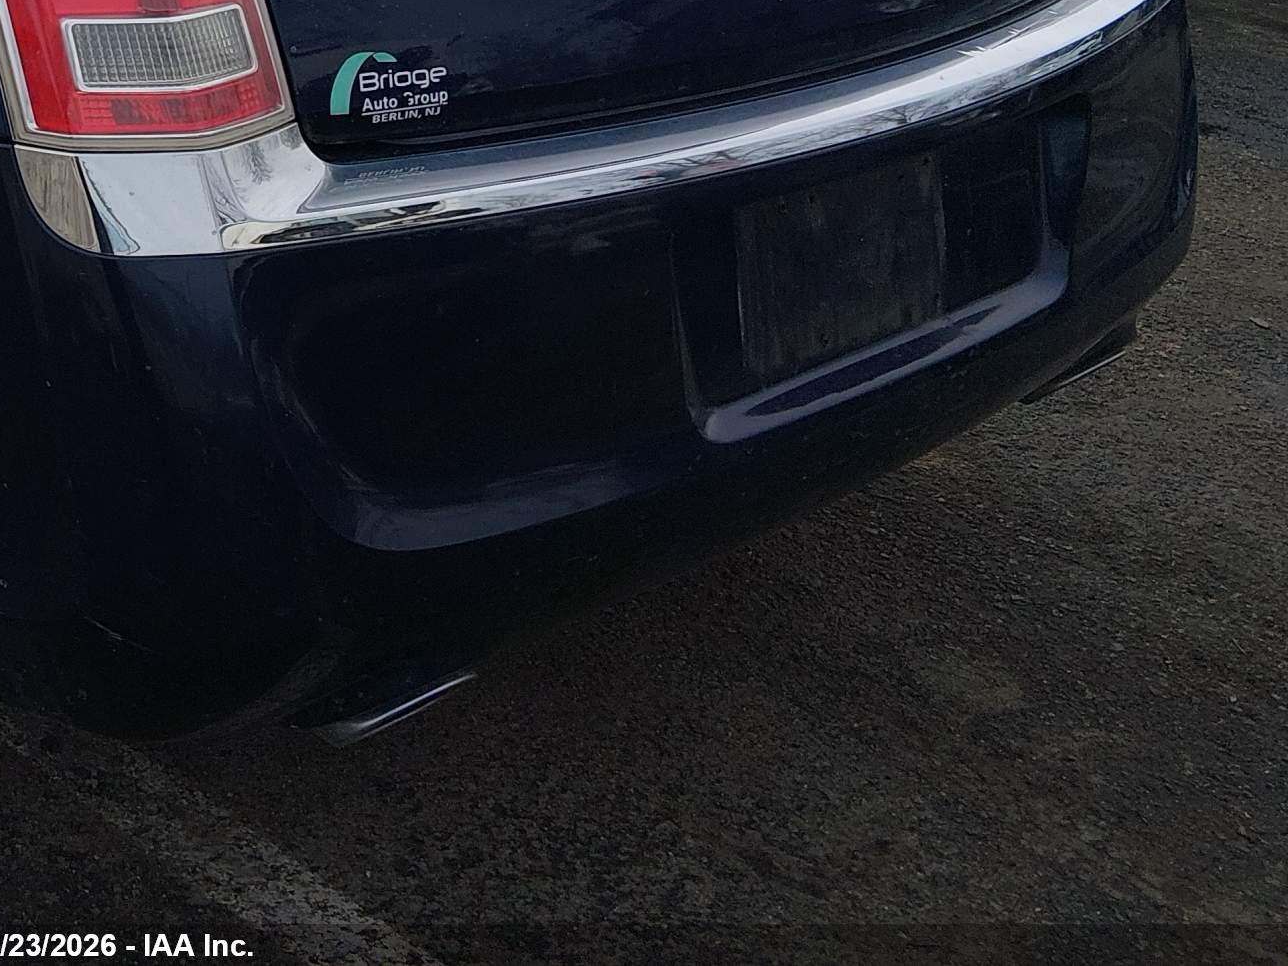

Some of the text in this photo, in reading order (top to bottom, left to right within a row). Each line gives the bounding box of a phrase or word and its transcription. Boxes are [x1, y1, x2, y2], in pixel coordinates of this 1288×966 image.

[362, 96, 398, 112] Auto
[372, 106, 441, 124] BERLIN, NJ
